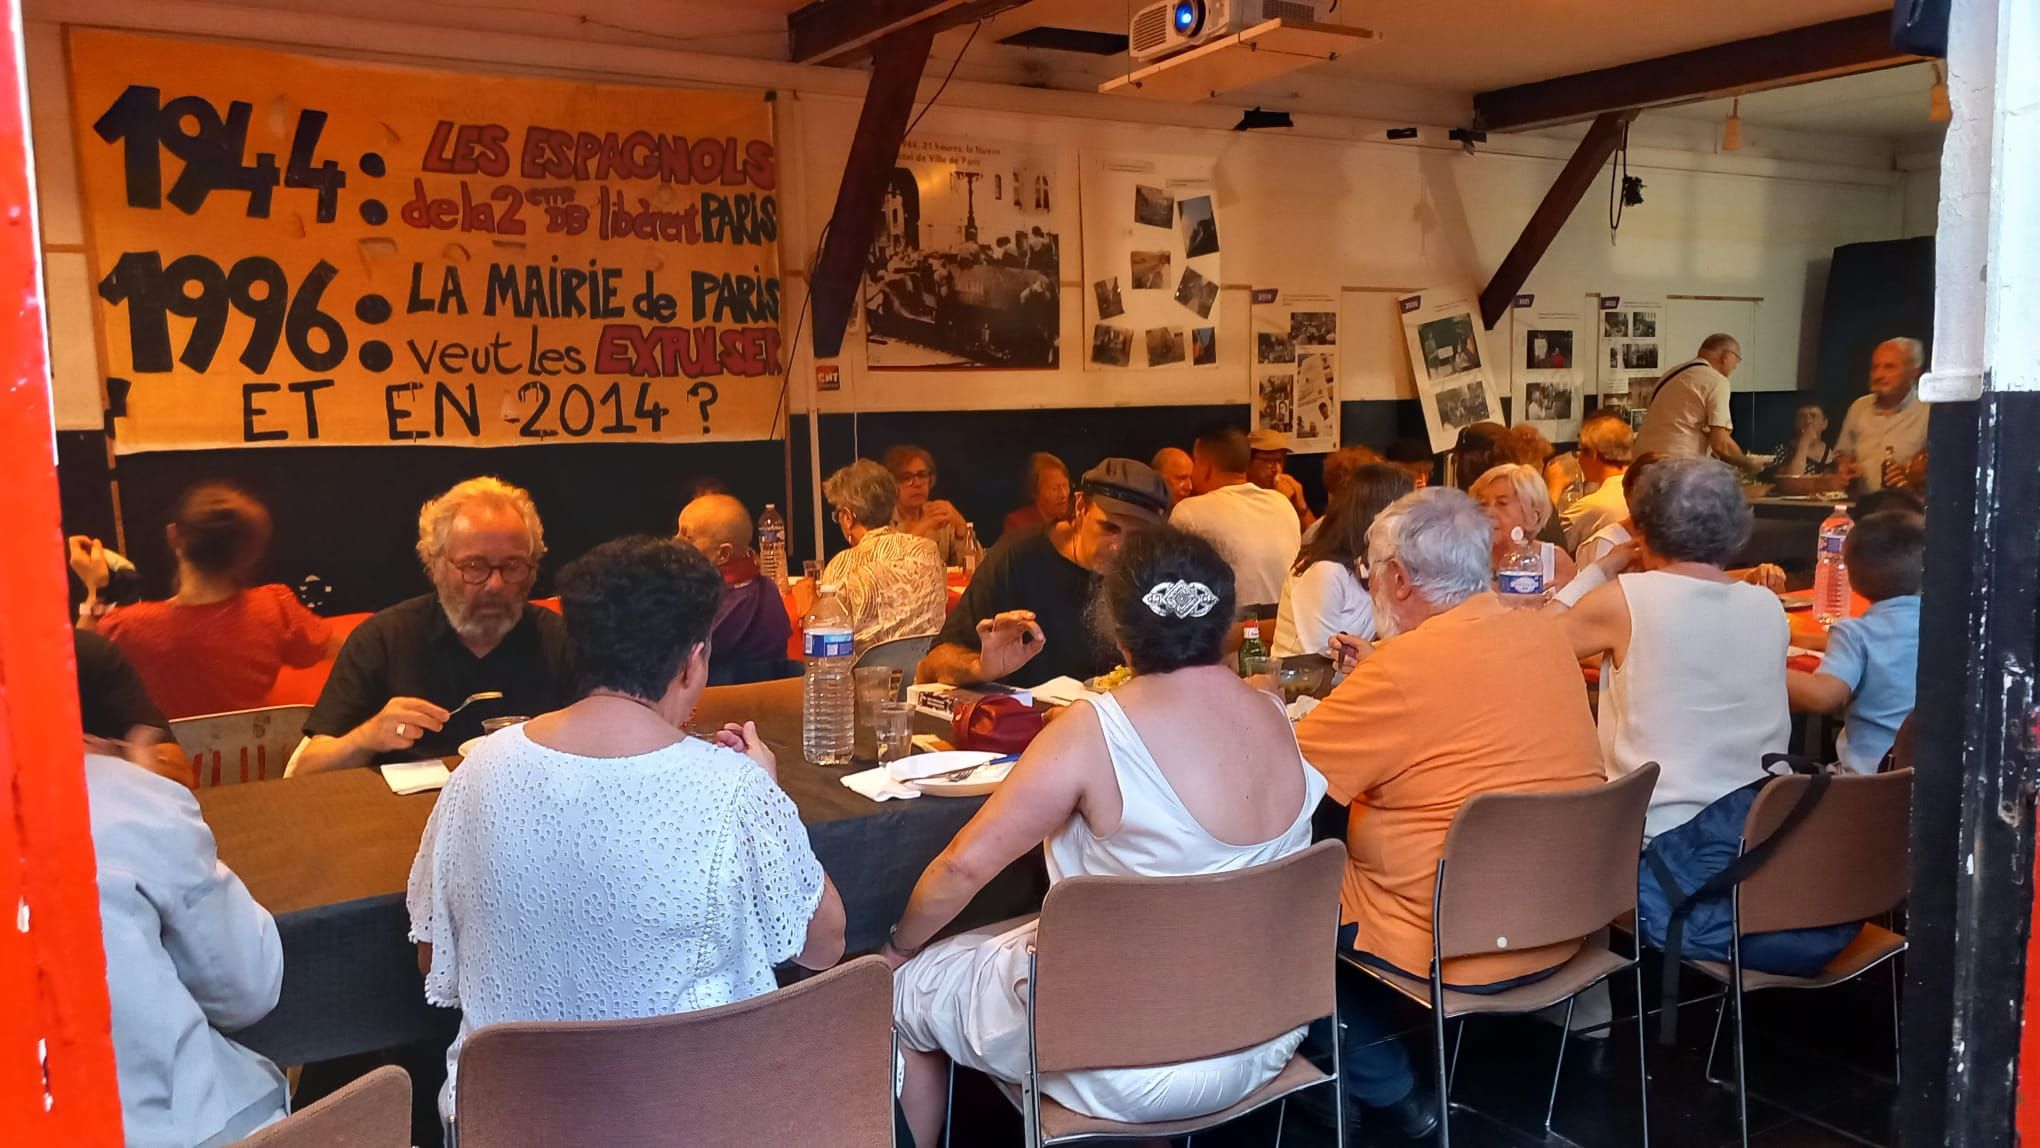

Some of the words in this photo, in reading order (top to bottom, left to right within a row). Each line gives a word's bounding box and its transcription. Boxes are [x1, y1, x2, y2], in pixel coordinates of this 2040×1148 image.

[422, 120, 510, 177] LES
[521, 126, 776, 190] ESPAGNOLS
[401, 178, 459, 230] de
[460, 181, 496, 234] la
[544, 204, 590, 235] DB
[98, 250, 394, 375] 1996:
[407, 262, 468, 315] LA
[632, 270, 678, 323] de
[407, 332, 522, 375] veut
[528, 324, 587, 376] les
[594, 323, 783, 379] EXPULSER
[243, 379, 336, 442] ET
[385, 381, 480, 441] EN
[518, 381, 670, 439] 2014
[689, 381, 718, 435] ?
